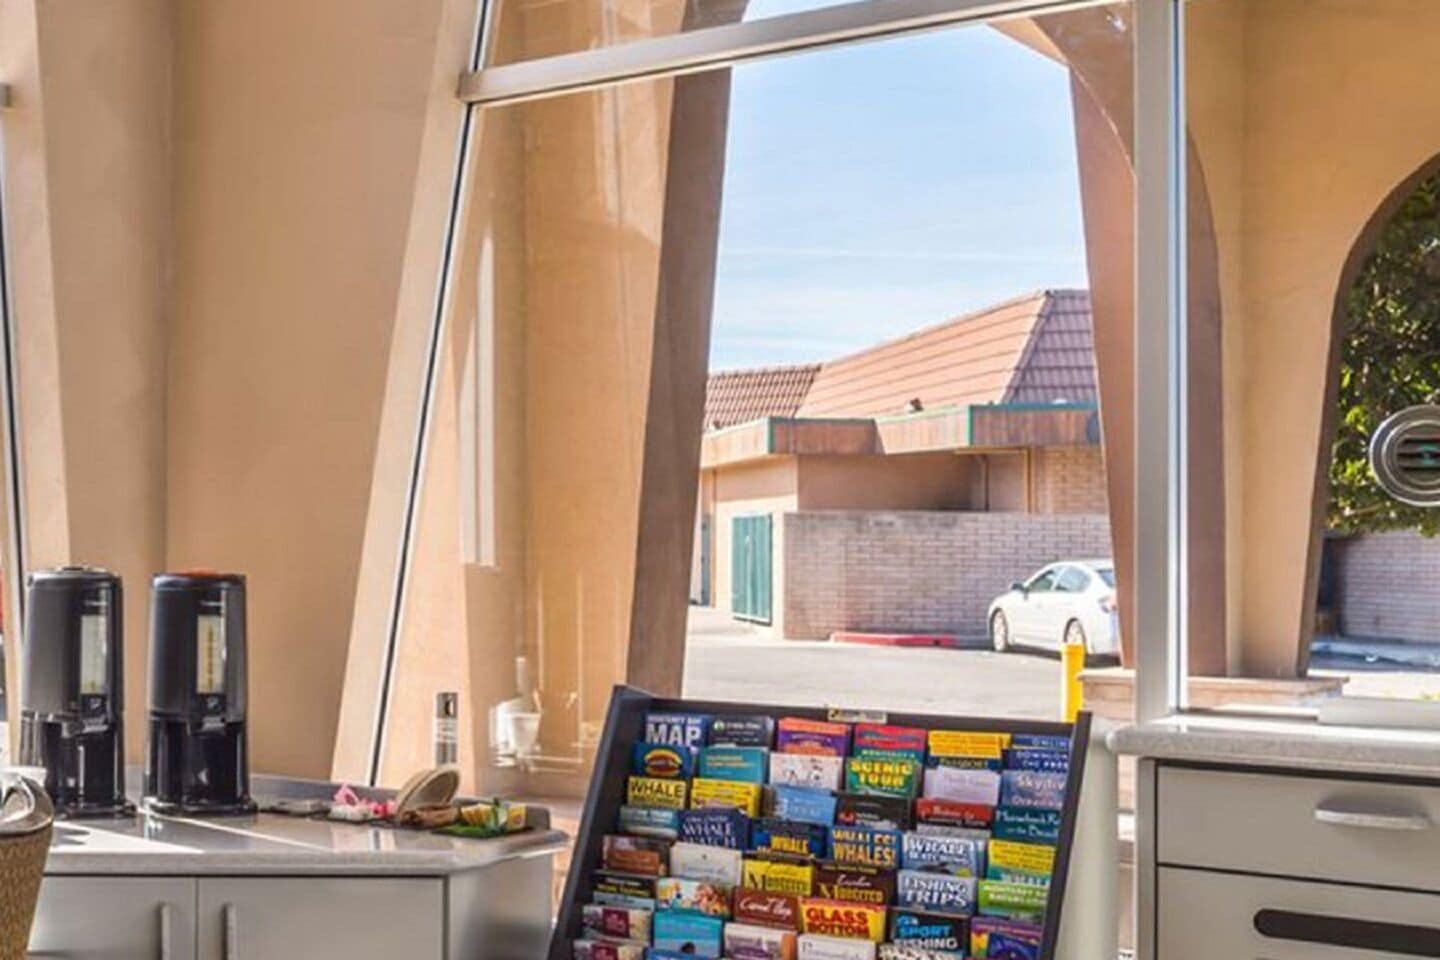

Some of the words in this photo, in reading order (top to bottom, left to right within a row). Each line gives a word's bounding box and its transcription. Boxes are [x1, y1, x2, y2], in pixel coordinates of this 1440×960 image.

[646, 722, 702, 747] MAP
[851, 760, 913, 775] SCENIC
[859, 773, 904, 787] TOUR
[629, 780, 685, 798] WHALE
[682, 821, 733, 836] WHALE
[770, 835, 809, 853] WHALE
[911, 838, 967, 855] WHALE
[833, 842, 896, 866] WHALES!
[904, 876, 968, 893] FISHING
[905, 889, 967, 908] TRIPS
[806, 906, 869, 925] GLASS
[807, 922, 870, 939] BOTTOM
[899, 924, 952, 939] SPORT
